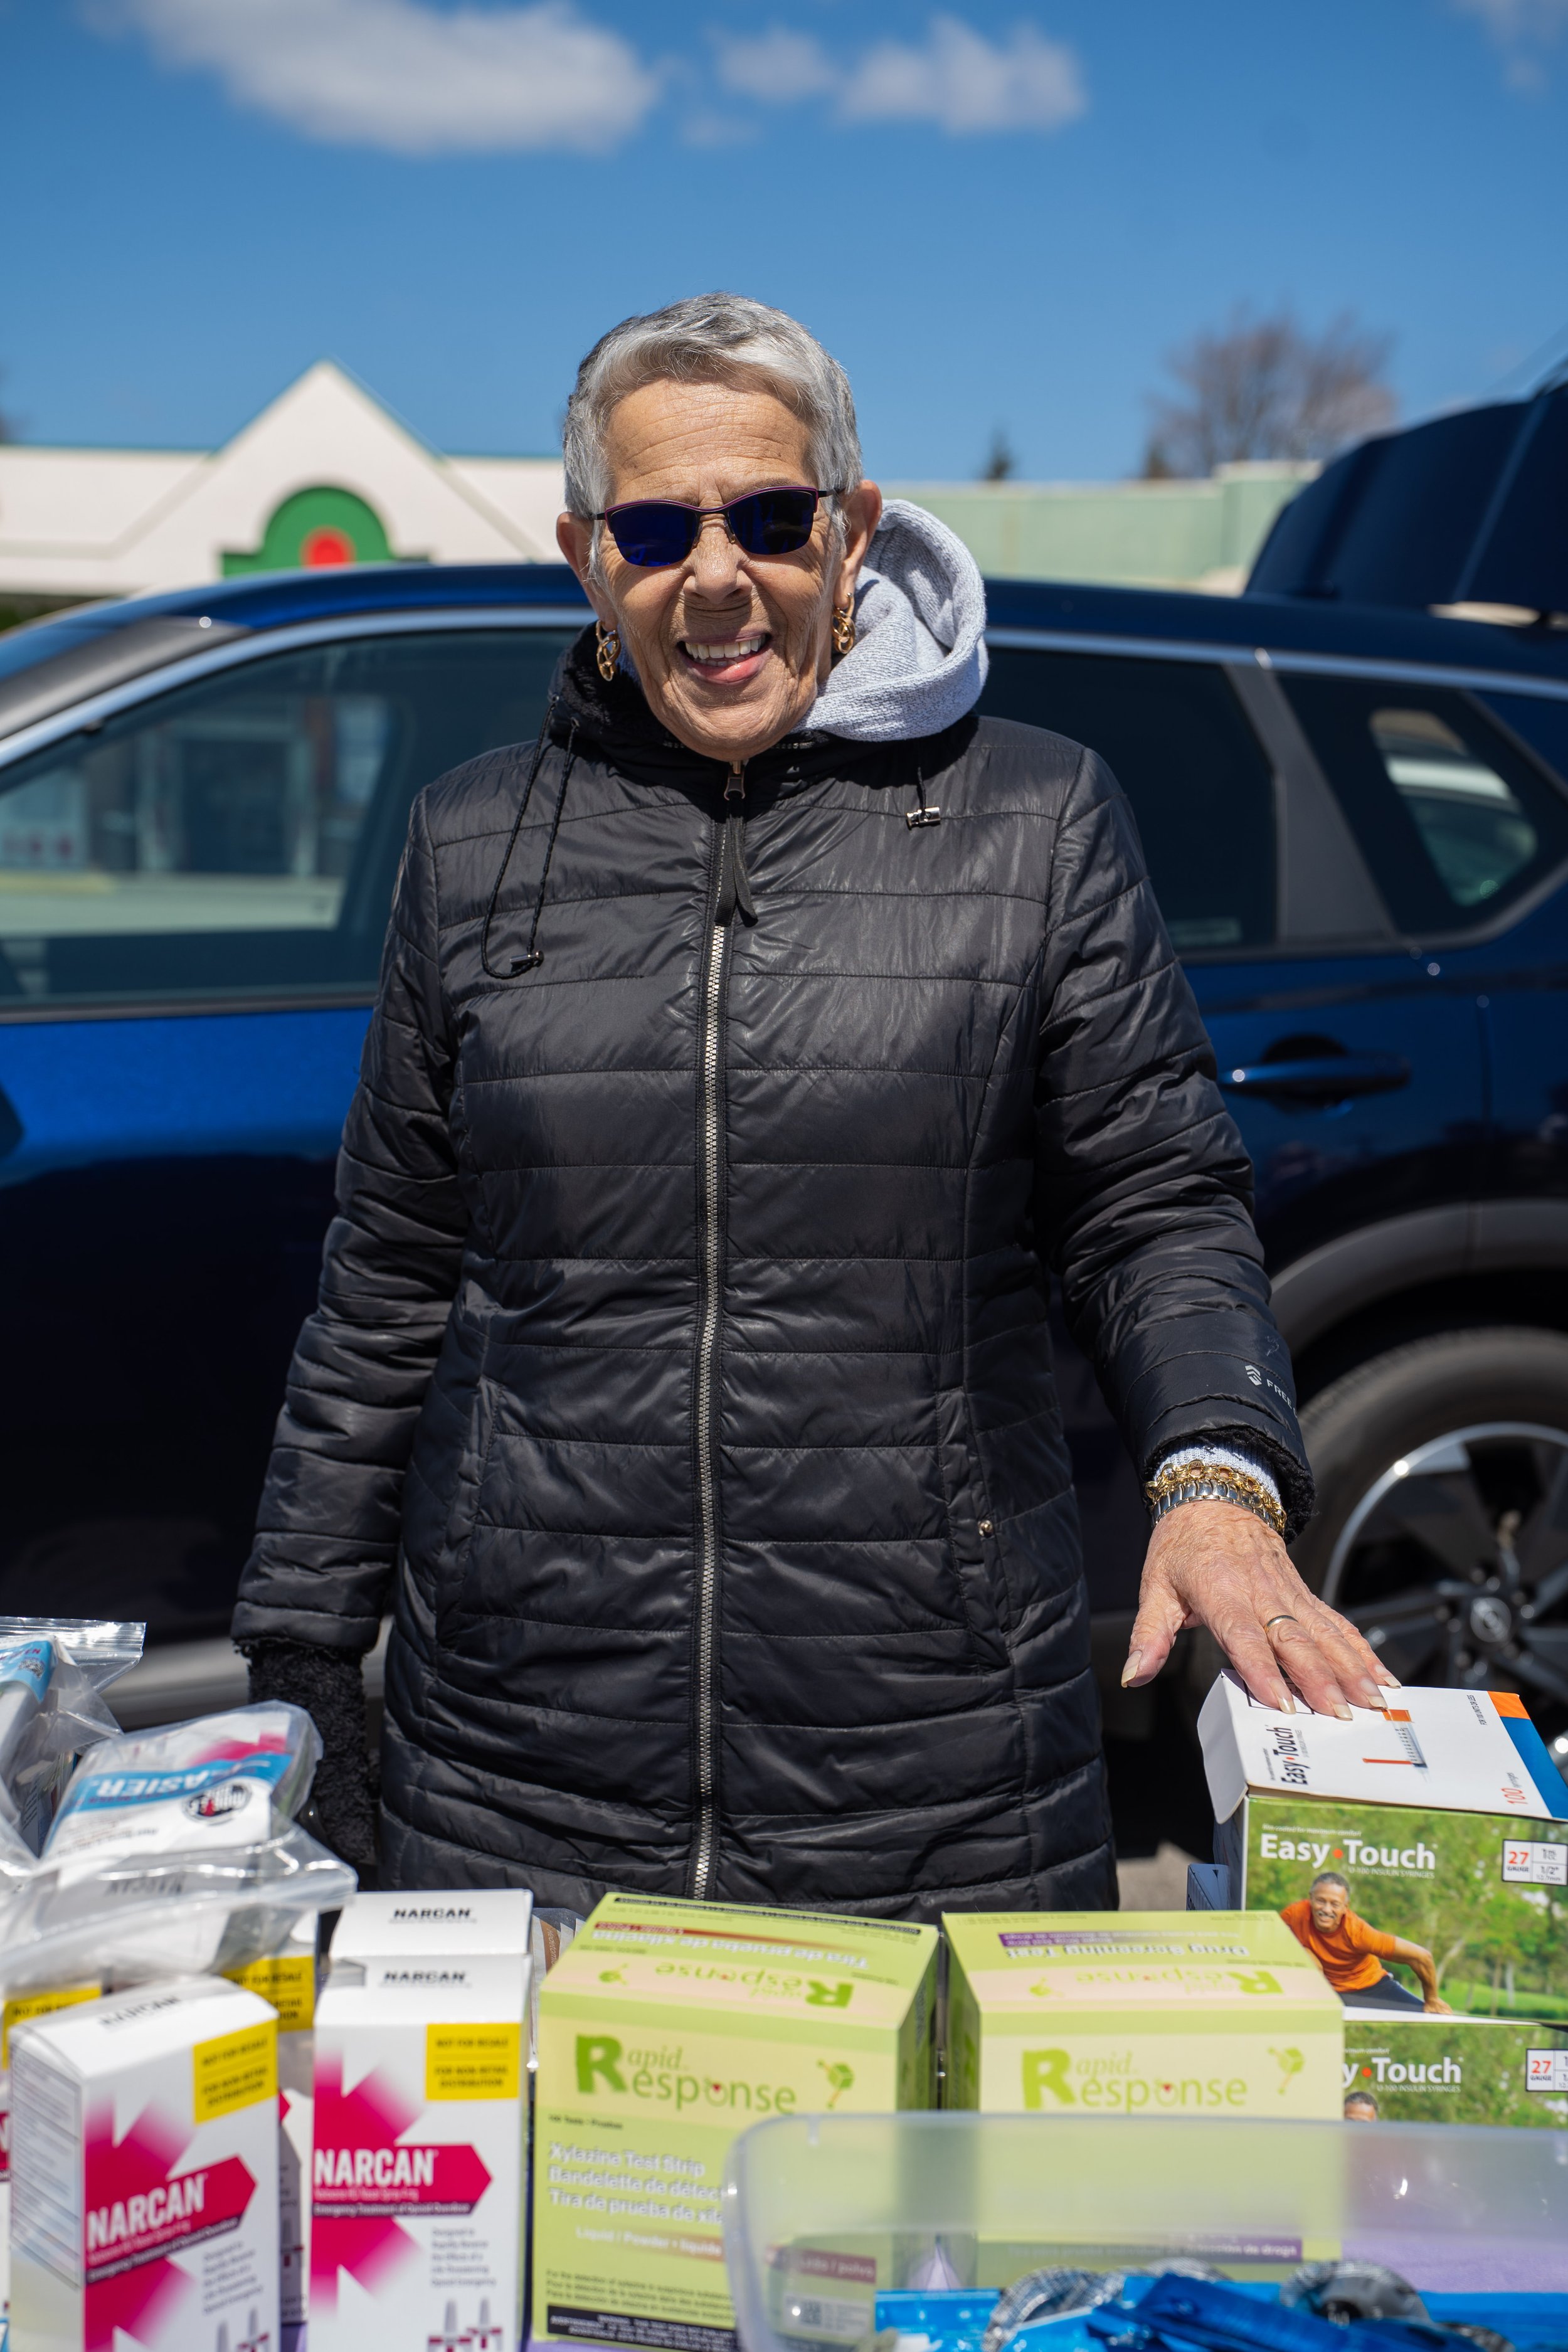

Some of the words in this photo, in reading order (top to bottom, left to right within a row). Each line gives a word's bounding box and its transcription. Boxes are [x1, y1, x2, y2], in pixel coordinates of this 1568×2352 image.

[1266, 1727, 1300, 1756] Touch
[1280, 1760, 1311, 1786] Easy
[1500, 1788, 1528, 1804] 100
[1261, 1832, 1331, 1869] Easy
[1342, 1838, 1436, 1870] Touch
[1508, 1851, 1529, 1865] 27
[1371, 1867, 1399, 1877] INSULIN
[1400, 1869, 1435, 1879] SYRINGES
[394, 1908, 471, 1919] NARCAN
[1006, 1944, 1061, 1959] Test
[1062, 1944, 1186, 1957] Screening
[1189, 1944, 1249, 1957] Drug
[384, 1971, 465, 1982] NARCAN
[100, 1994, 182, 2025] NARCAN
[1371, 2057, 1462, 2084] Touch
[1531, 2060, 1552, 2074] 27
[1399, 2084, 1427, 2092] INSULIN
[1428, 2085, 1461, 2093] SYRINGES
[314, 2148, 435, 2187] NARCAN
[549, 2140, 622, 2168] Xylazine
[623, 2149, 659, 2170] Test
[662, 2154, 706, 2180] Strip
[548, 2165, 642, 2191] Bandelette
[645, 2176, 667, 2194] de
[87, 2172, 206, 2251] NARCAN
[548, 2187, 583, 2208] Tira
[584, 2192, 607, 2212] de
[608, 2197, 670, 2219] prueba
[672, 2201, 694, 2221] de
[697, 2206, 725, 2225] xila
